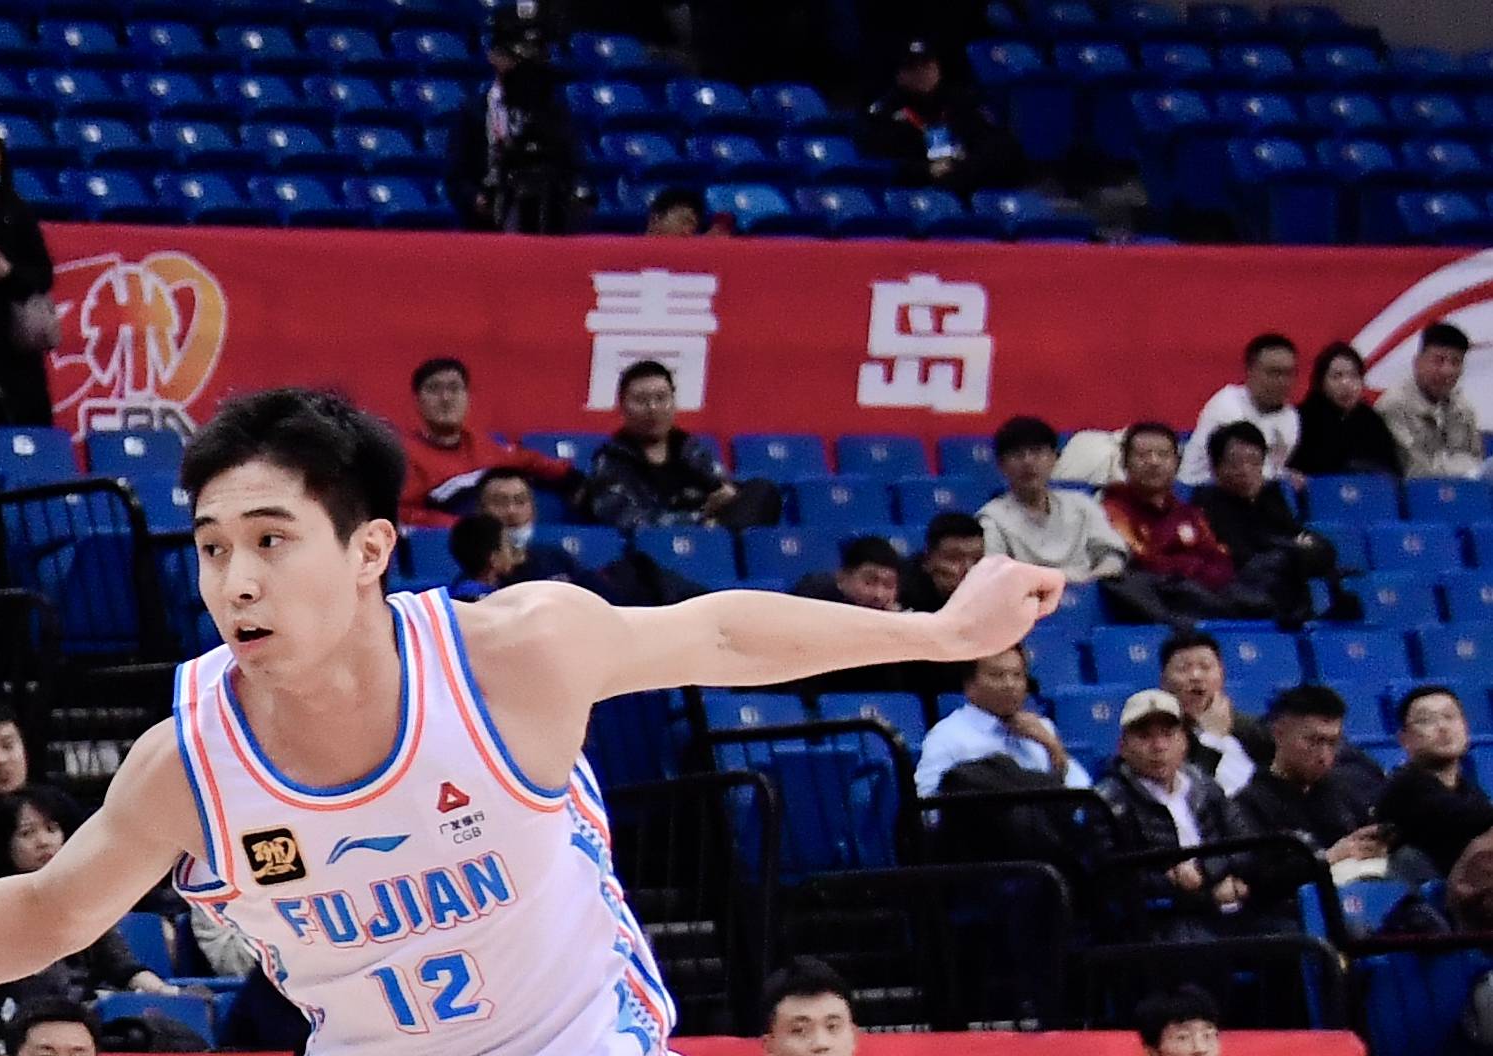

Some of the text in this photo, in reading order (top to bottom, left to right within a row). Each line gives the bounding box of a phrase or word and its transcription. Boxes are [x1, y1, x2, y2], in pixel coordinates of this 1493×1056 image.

[585, 268, 994, 414] 青岛
[453, 826, 482, 845] CGB
[272, 851, 518, 947] FUJIAN
[364, 950, 495, 1034] 12
